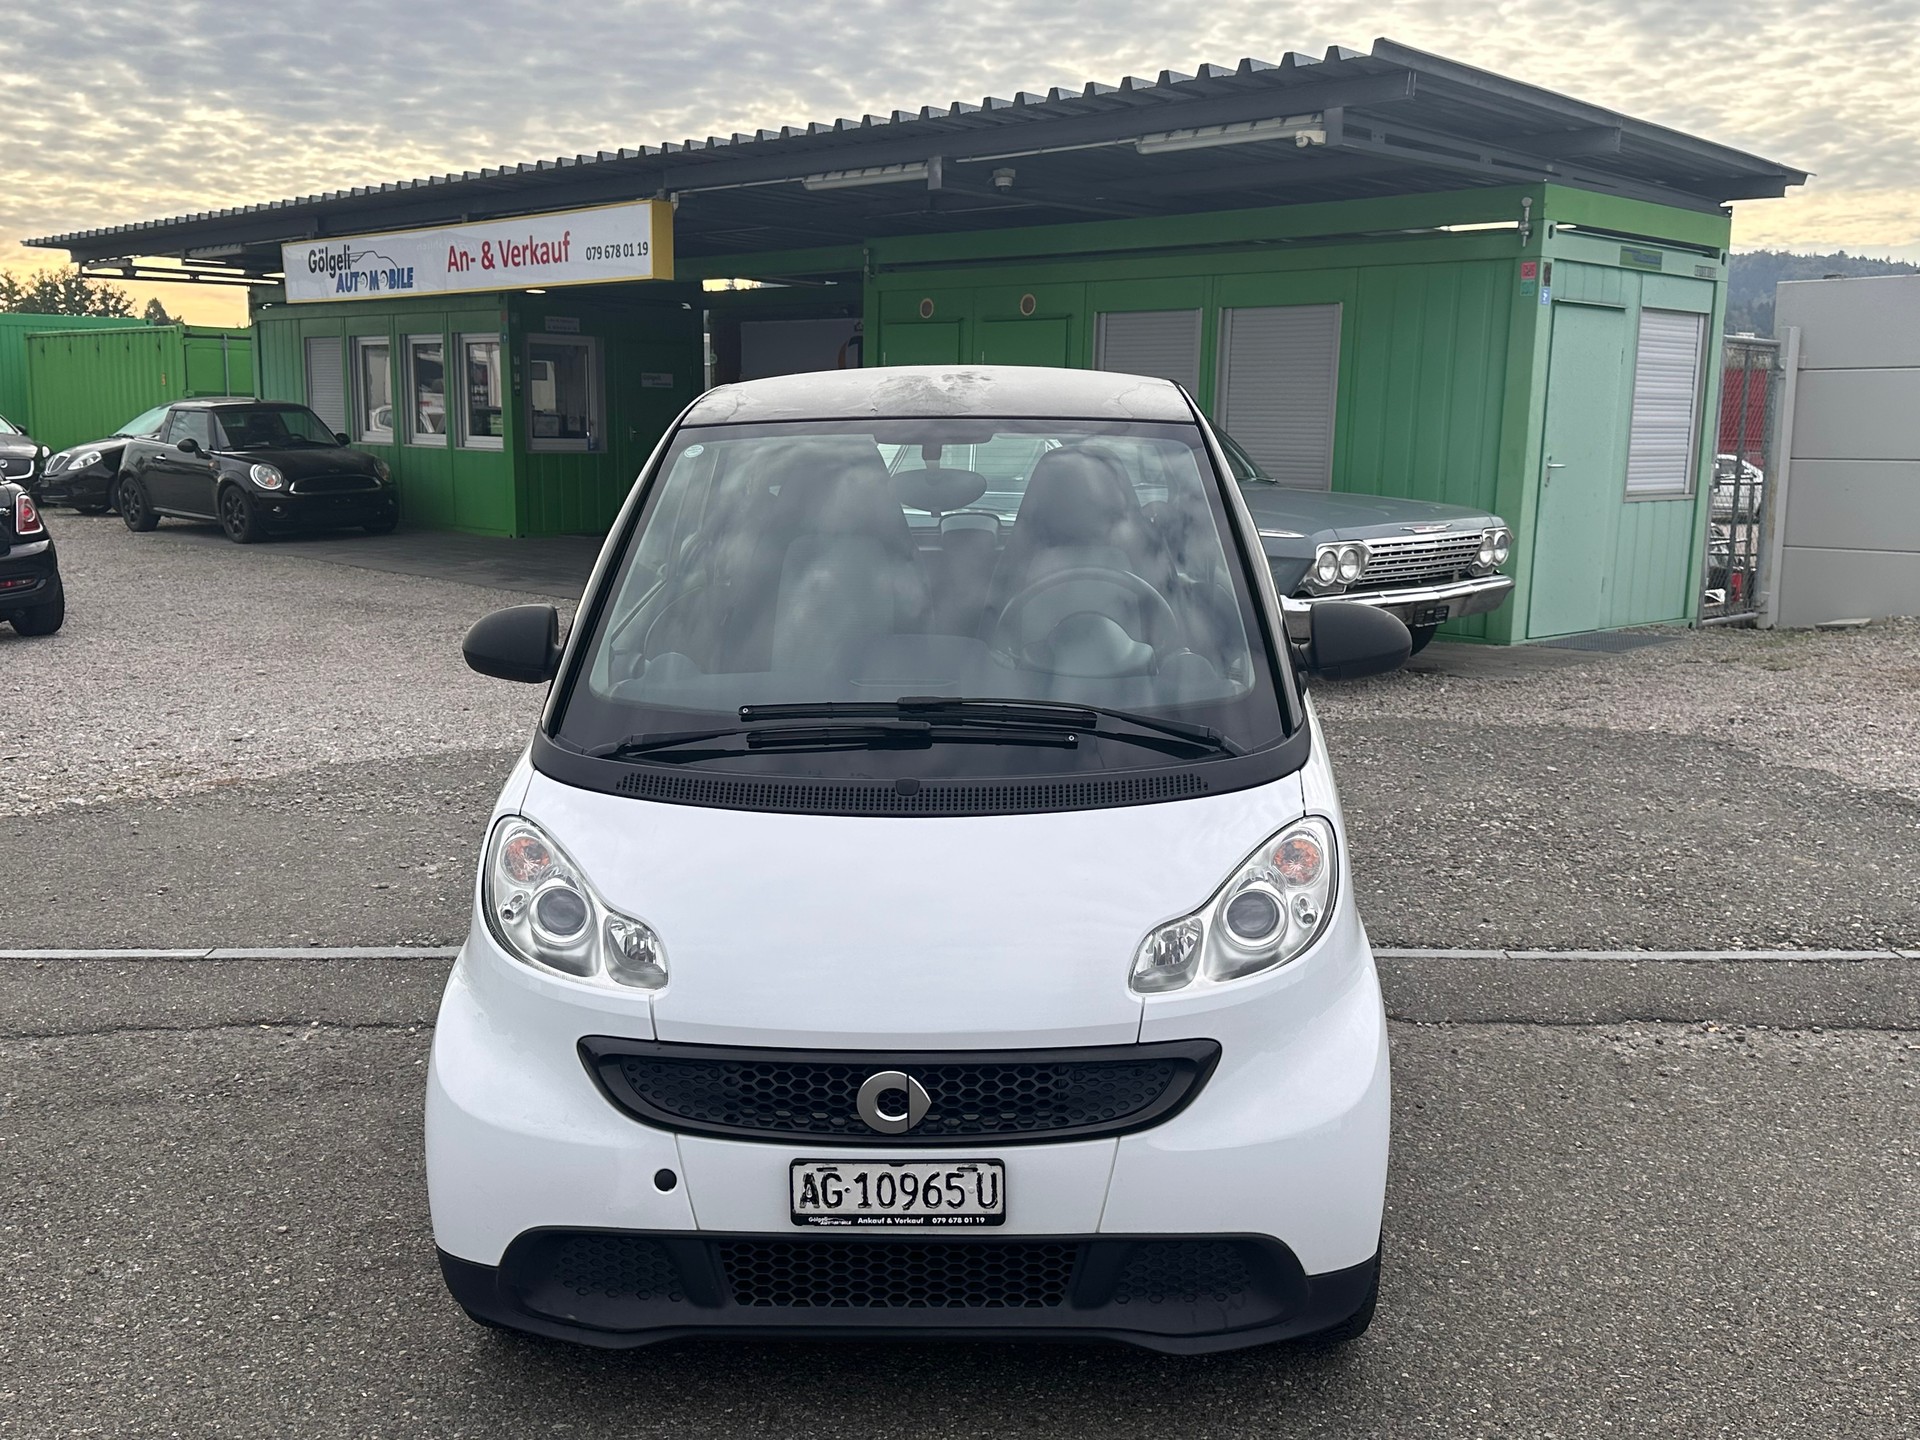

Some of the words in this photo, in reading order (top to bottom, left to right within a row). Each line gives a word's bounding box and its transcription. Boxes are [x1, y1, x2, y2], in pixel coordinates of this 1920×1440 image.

[308, 244, 351, 279] Gölgeli
[447, 245, 476, 273] An-
[481, 241, 496, 271] &
[498, 230, 570, 268] Verkauf
[585, 246, 603, 261] 079
[604, 244, 622, 259] 678
[623, 243, 635, 258] 01
[637, 241, 649, 256] 19
[336, 267, 414, 293] AUTOMOBILE
